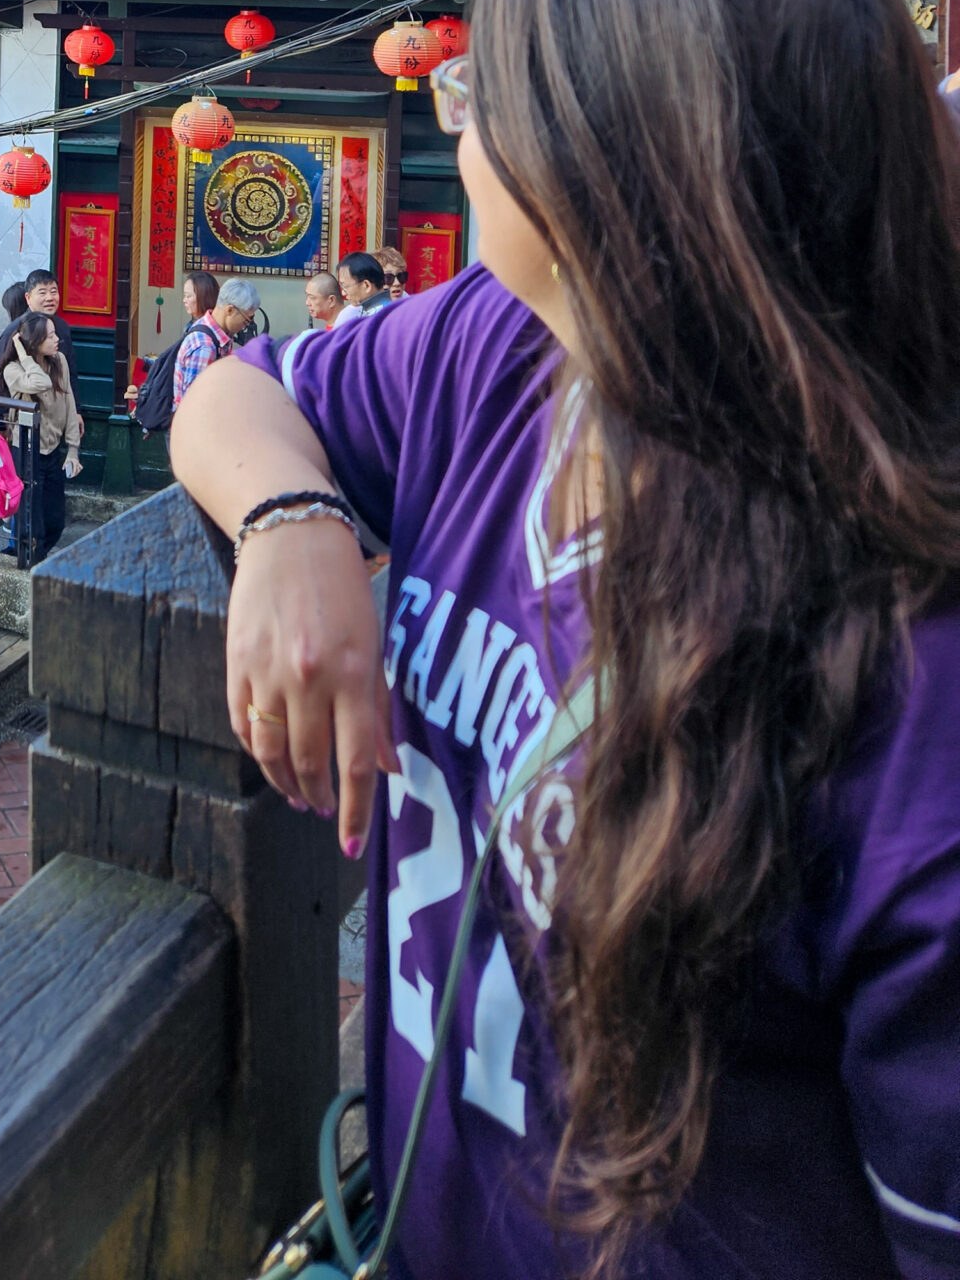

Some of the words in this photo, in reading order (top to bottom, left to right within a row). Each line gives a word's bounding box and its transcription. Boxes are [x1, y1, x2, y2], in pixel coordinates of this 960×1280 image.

[244, 19, 256, 47] 九份
[90, 35, 103, 61] 九份
[403, 35, 420, 70] 九份
[1, 162, 15, 191] 九份
